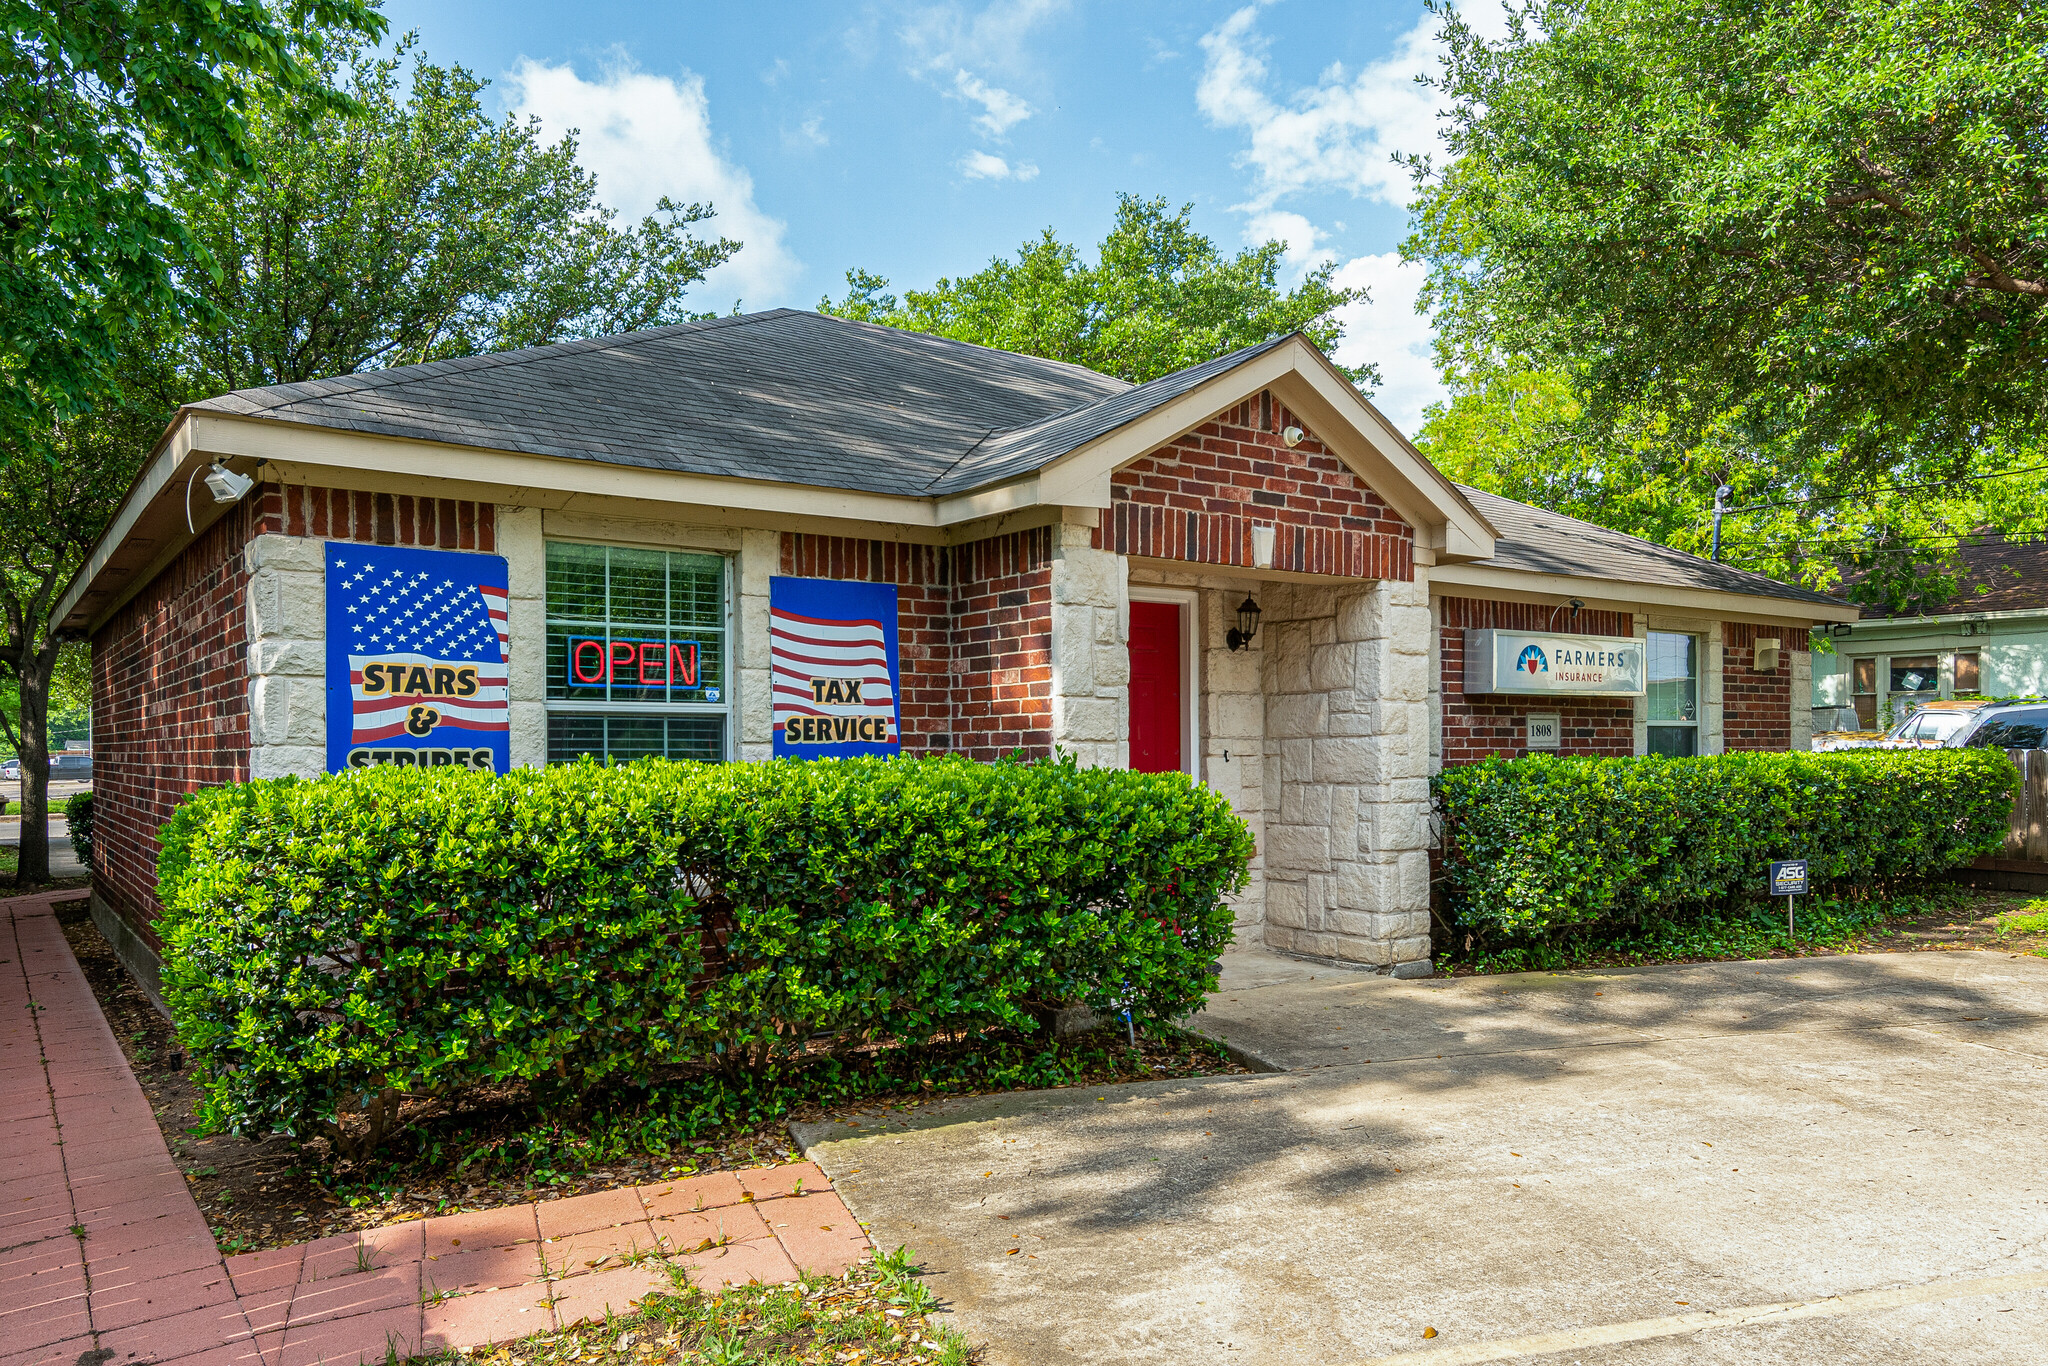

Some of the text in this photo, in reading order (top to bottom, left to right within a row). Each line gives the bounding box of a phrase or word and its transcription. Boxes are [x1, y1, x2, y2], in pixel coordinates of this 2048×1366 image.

[574, 640, 695, 685] OPEN
[1555, 649, 1624, 667] FARMERS
[364, 664, 477, 696] STARS
[1555, 672, 1603, 682] INSURANCE
[811, 679, 862, 704] TAX
[408, 707, 438, 735] &
[786, 717, 886, 742] SERVICE
[1530, 724, 1552, 737] 1808
[1776, 866, 1804, 879] ASG
